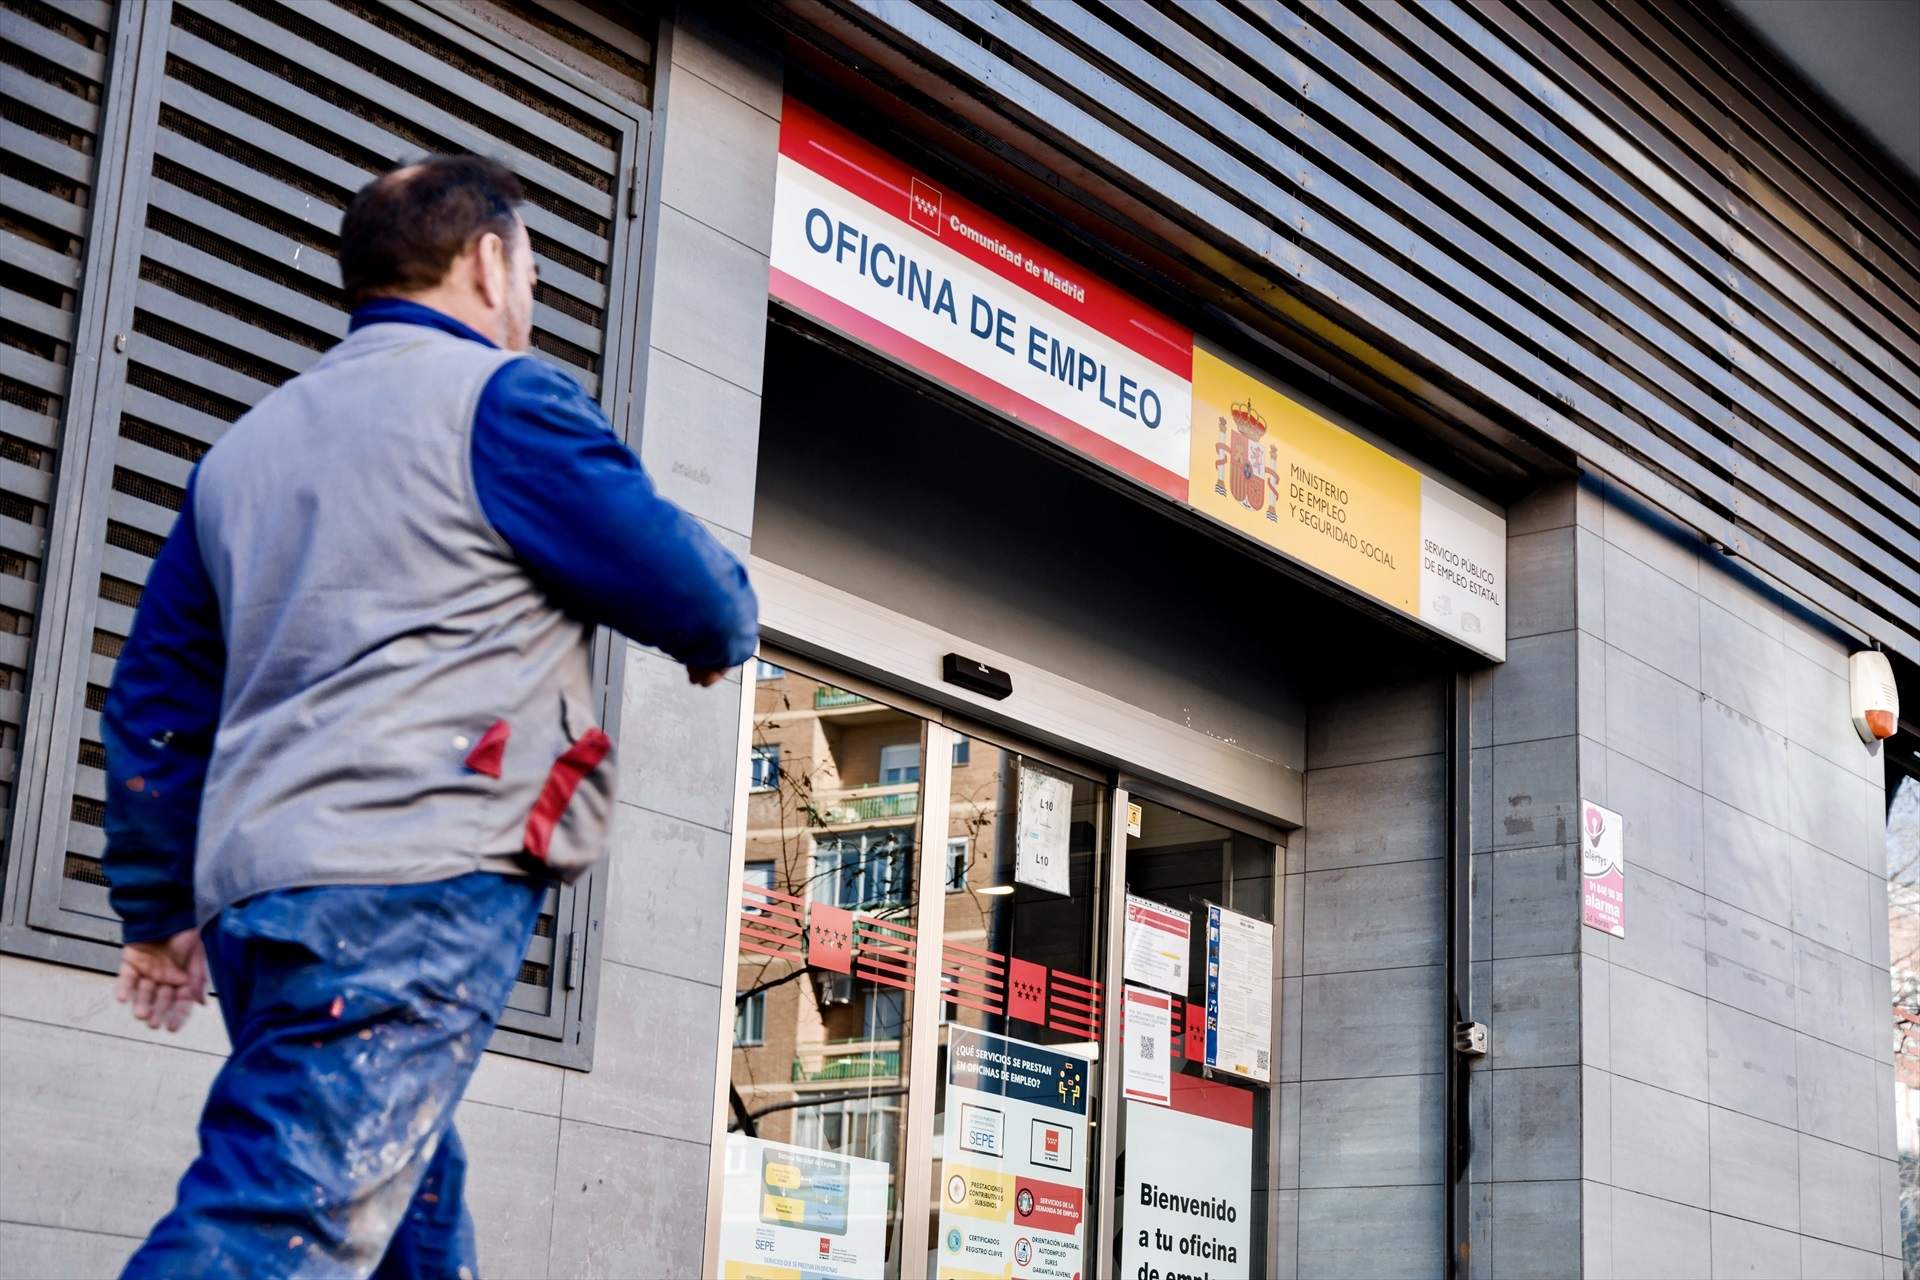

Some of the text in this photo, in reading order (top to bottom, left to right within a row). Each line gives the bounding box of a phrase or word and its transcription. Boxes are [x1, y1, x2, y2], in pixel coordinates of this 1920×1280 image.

[950, 215, 1085, 303] Comunidad de Madrid
[805, 208, 1162, 430] OFICINA DE EMPLEO
[1290, 463, 1348, 505] MINISTERIO
[1290, 483, 1346, 523] DE EMPLEO
[1289, 503, 1396, 570] Y SEGURIDAD SOCIAL
[1425, 539, 1494, 584] SERVICIO PÚBLICO
[1425, 557, 1499, 606] DE EMPLEO ESTATAL
[1035, 854, 1049, 866] L10
[1585, 893, 1620, 918] alarma
[956, 1044, 1052, 1075] ¿QUÉ SERVICIOS SE PRESTAN
[956, 1061, 1041, 1089] EN OFICINAS DE EMPLEO?
[969, 1130, 995, 1148] SEPE
[1140, 1182, 1237, 1223] Bienvenido
[755, 1239, 775, 1251] SEPE
[969, 1234, 1000, 1246] CERTIFICADOS
[1139, 1228, 1237, 1264] a tu oficina
[1138, 1262, 1159, 1280] de
